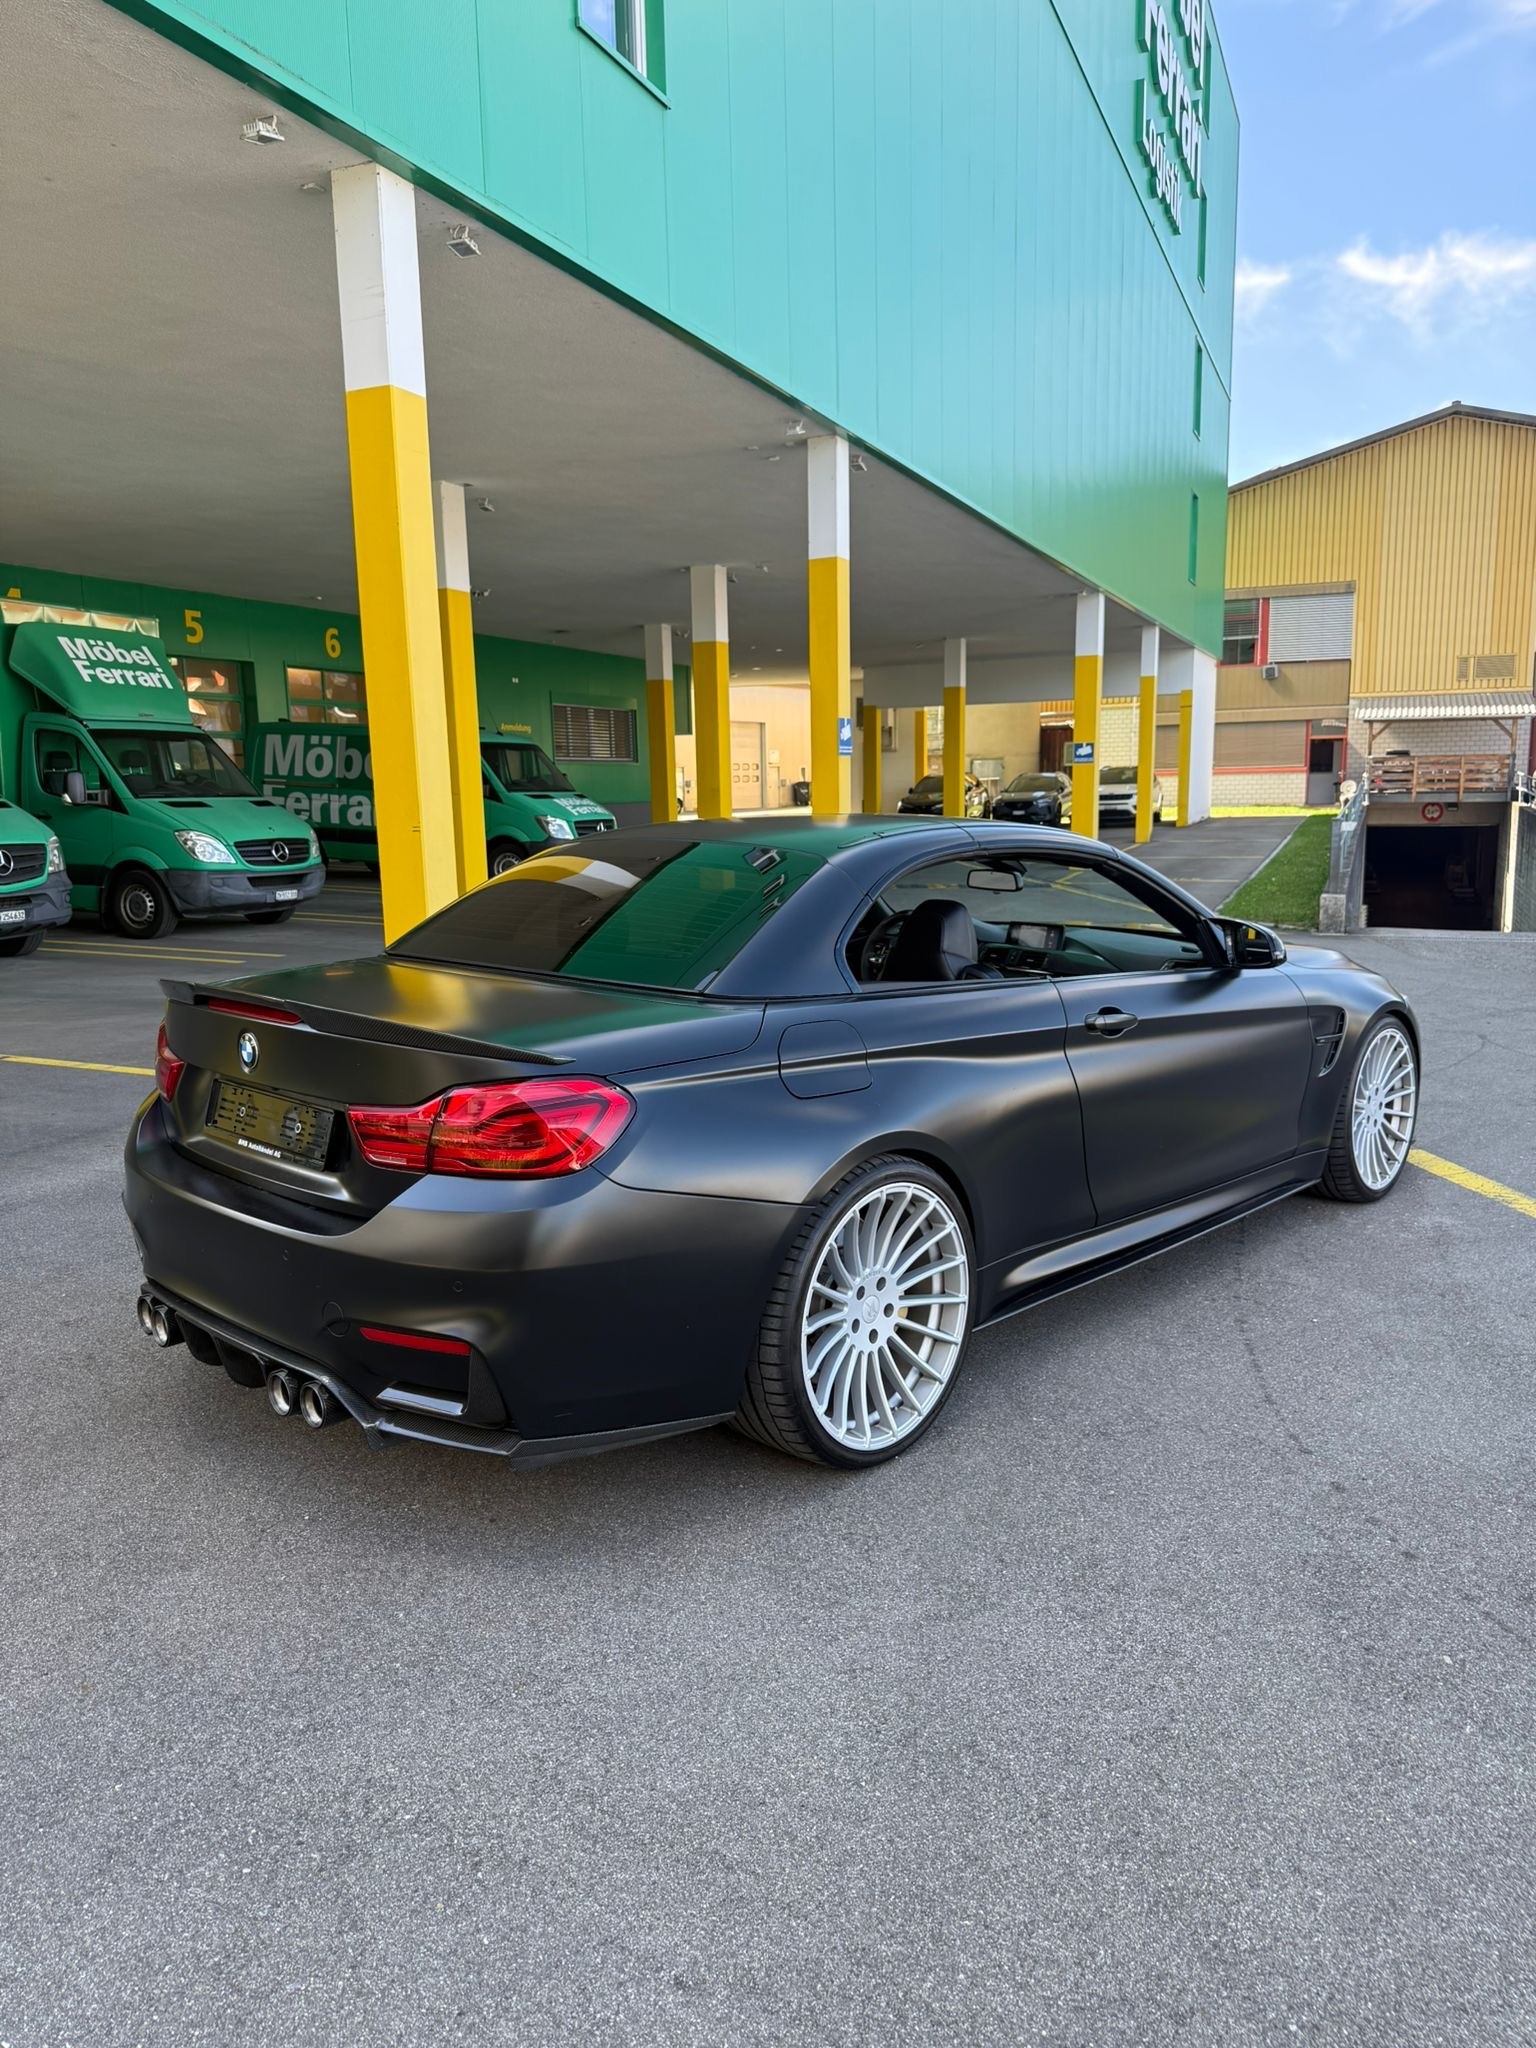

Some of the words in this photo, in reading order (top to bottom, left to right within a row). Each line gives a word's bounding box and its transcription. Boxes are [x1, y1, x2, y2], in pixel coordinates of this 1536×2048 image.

[1142, 79, 1182, 235] Logistik
[184, 609, 204, 643] 5
[57, 636, 159, 667] Möbel
[325, 628, 342, 659] 6
[72, 660, 174, 689] Ferrari
[263, 734, 373, 779] Möb
